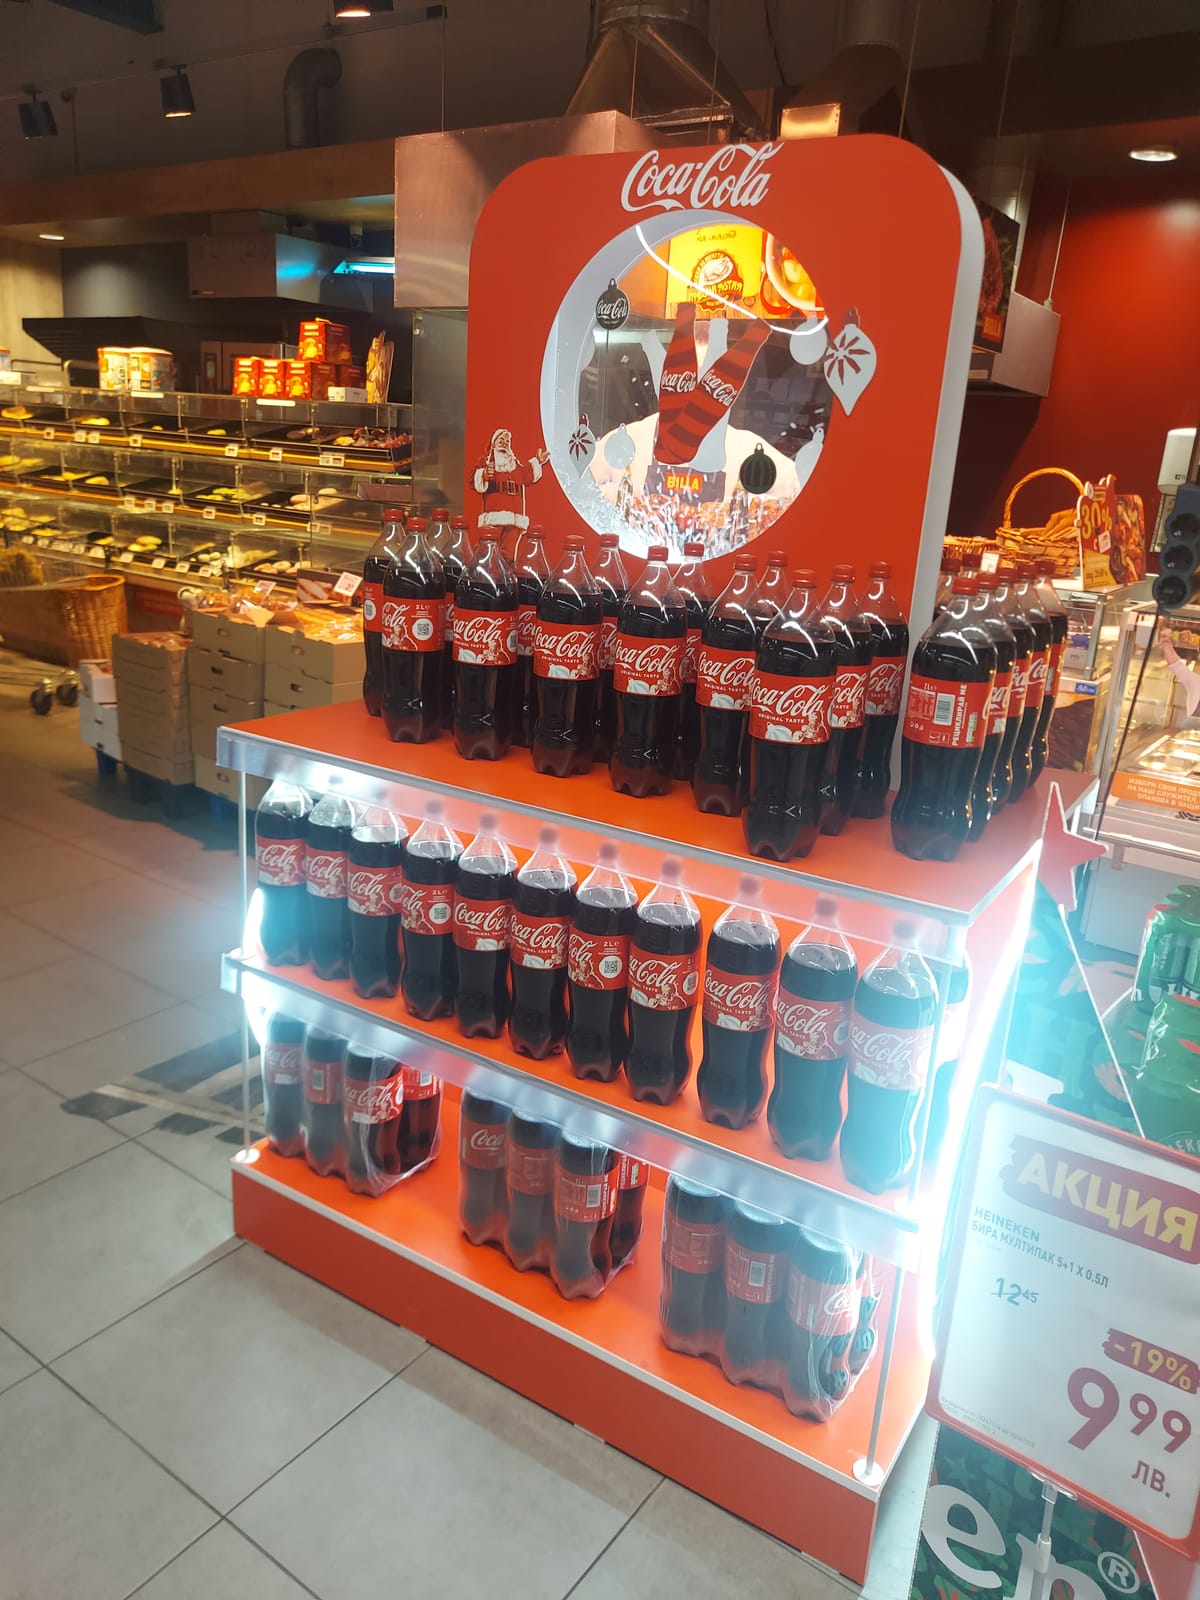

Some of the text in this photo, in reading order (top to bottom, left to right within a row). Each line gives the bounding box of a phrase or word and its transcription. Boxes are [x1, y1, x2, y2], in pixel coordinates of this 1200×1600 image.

[621, 142, 784, 212] Coca-Cola
[596, 297, 628, 319] Coca-Cola
[661, 370, 697, 393] Coca-Cola
[701, 369, 738, 407] Coca-Cola
[667, 476, 700, 490] BILLA
[535, 626, 598, 658] Coca-Cola
[615, 639, 680, 673] Coca-Cola
[751, 677, 830, 717] Coca-Cola
[951, 684, 968, 746] РЕЦИКЛИРАЙ МЕ
[758, 713, 784, 722] ORIGINAL
[1127, 784, 1137, 792] НА
[511, 914, 570, 949] Coca-Cola
[705, 969, 770, 1009] Coca-Cola
[1016, 1151, 1199, 1252] АКЦИЯ
[974, 1206, 1041, 1242] HEINEKEN
[971, 1220, 998, 1240] БИРА
[1000, 1233, 1056, 1265] МУЛТИПАК
[1056, 1256, 1075, 1273] 5+1
[1085, 1269, 1110, 1289] 0.5Л
[1113, 1341, 1193, 1391] -19%
